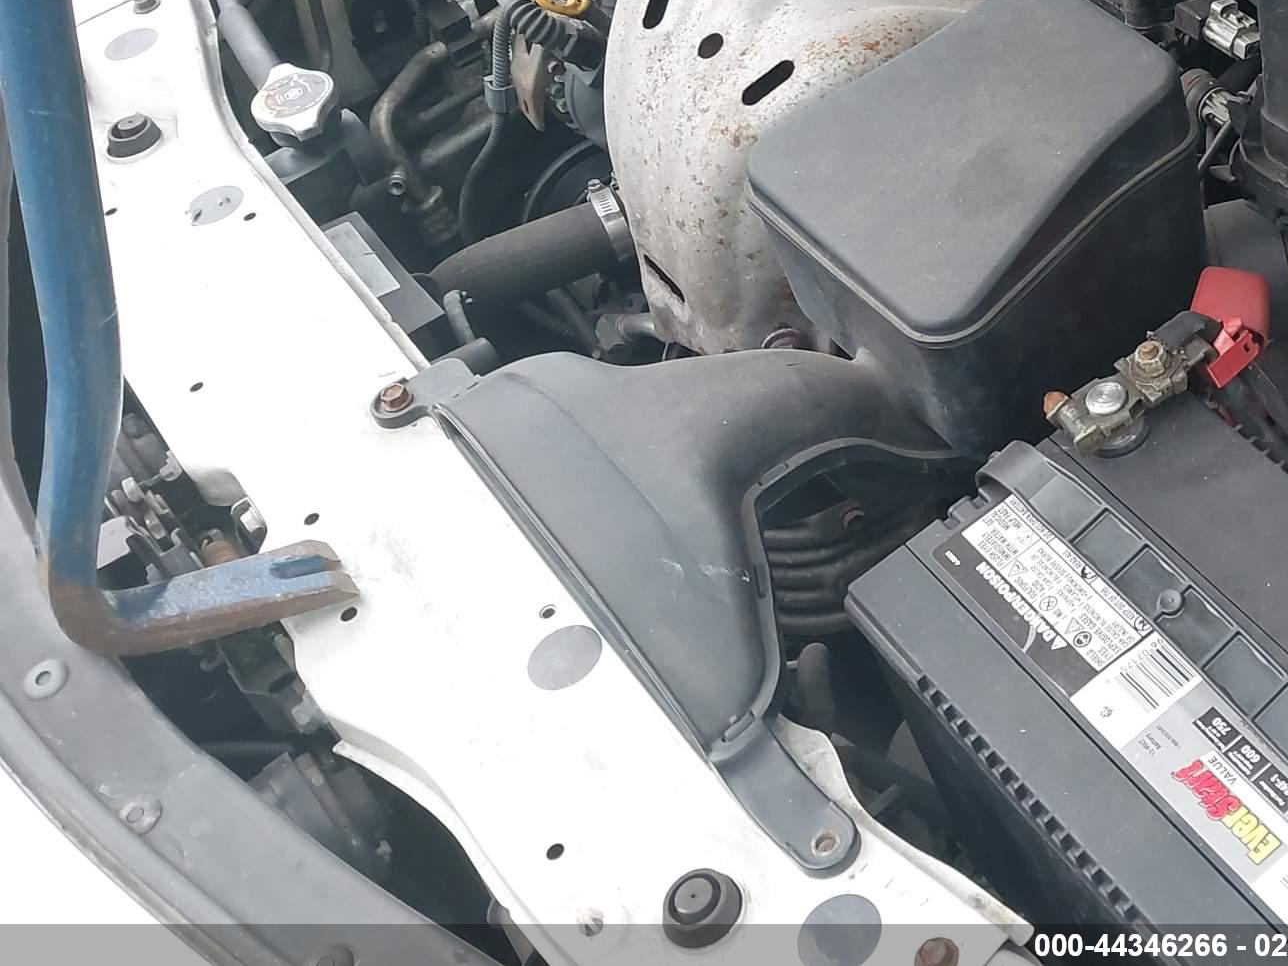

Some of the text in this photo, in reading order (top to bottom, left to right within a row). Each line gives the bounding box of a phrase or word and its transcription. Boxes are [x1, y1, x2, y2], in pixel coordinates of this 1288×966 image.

[981, 516, 994, 526] GET
[990, 510, 1011, 531] MEDICAL
[1007, 517, 1023, 529] HELP
[1034, 522, 1047, 533] NOT
[977, 540, 1004, 567] FLUSH EYES
[982, 533, 1011, 560] IMMEDIATELY
[1005, 543, 1018, 555] WITH
[1062, 549, 1083, 569] READ ALL
[1013, 576, 1038, 599] SULFURIC
[1031, 579, 1045, 593] ACID
[976, 562, 1055, 640] DANGER/POISON
[1100, 586, 1135, 621] KEEP OUT OF THE
[1053, 608, 1062, 618] NO
[1082, 603, 1107, 627] BLINDNESS
[1078, 613, 1122, 654] EXPLOSIVE GASES
[1104, 624, 1120, 639] CAUSE
[1086, 648, 1105, 667] SHIELD
[1212, 717, 1231, 735] 750
[1240, 745, 1260, 762] 600
[1207, 755, 1237, 785] VALUE
[1172, 759, 1282, 866] EverStart
